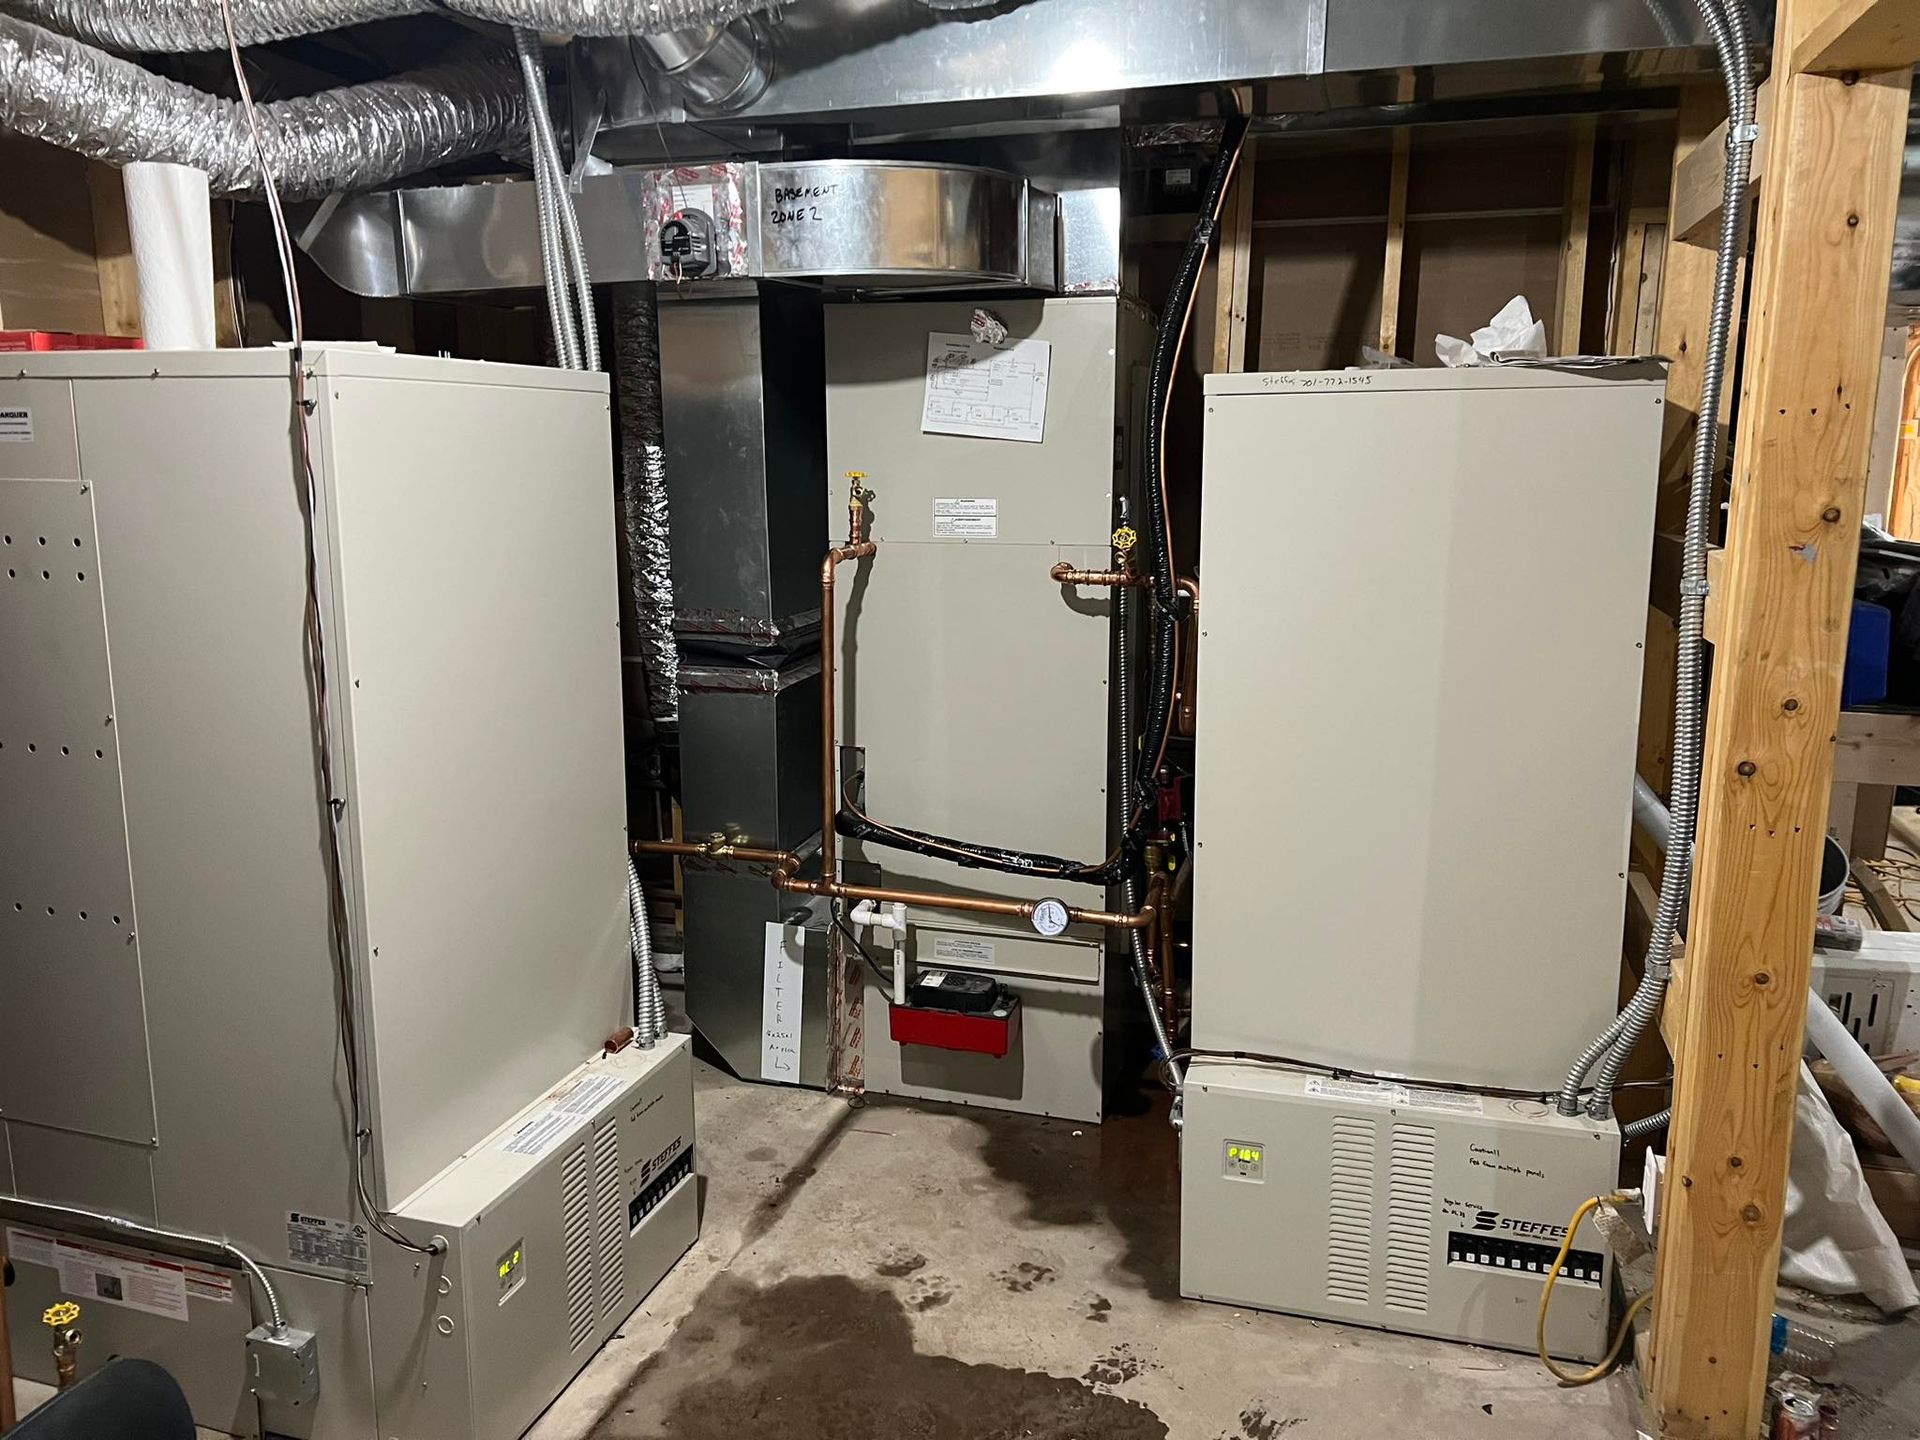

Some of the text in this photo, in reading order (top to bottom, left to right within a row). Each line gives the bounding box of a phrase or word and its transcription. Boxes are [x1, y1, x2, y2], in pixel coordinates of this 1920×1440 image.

[775, 184, 838, 203] BASEMENT
[771, 206, 823, 224] ZONE 2
[651, 1135, 682, 1172] STEFFES
[1500, 1218, 1569, 1238] STEFFES
